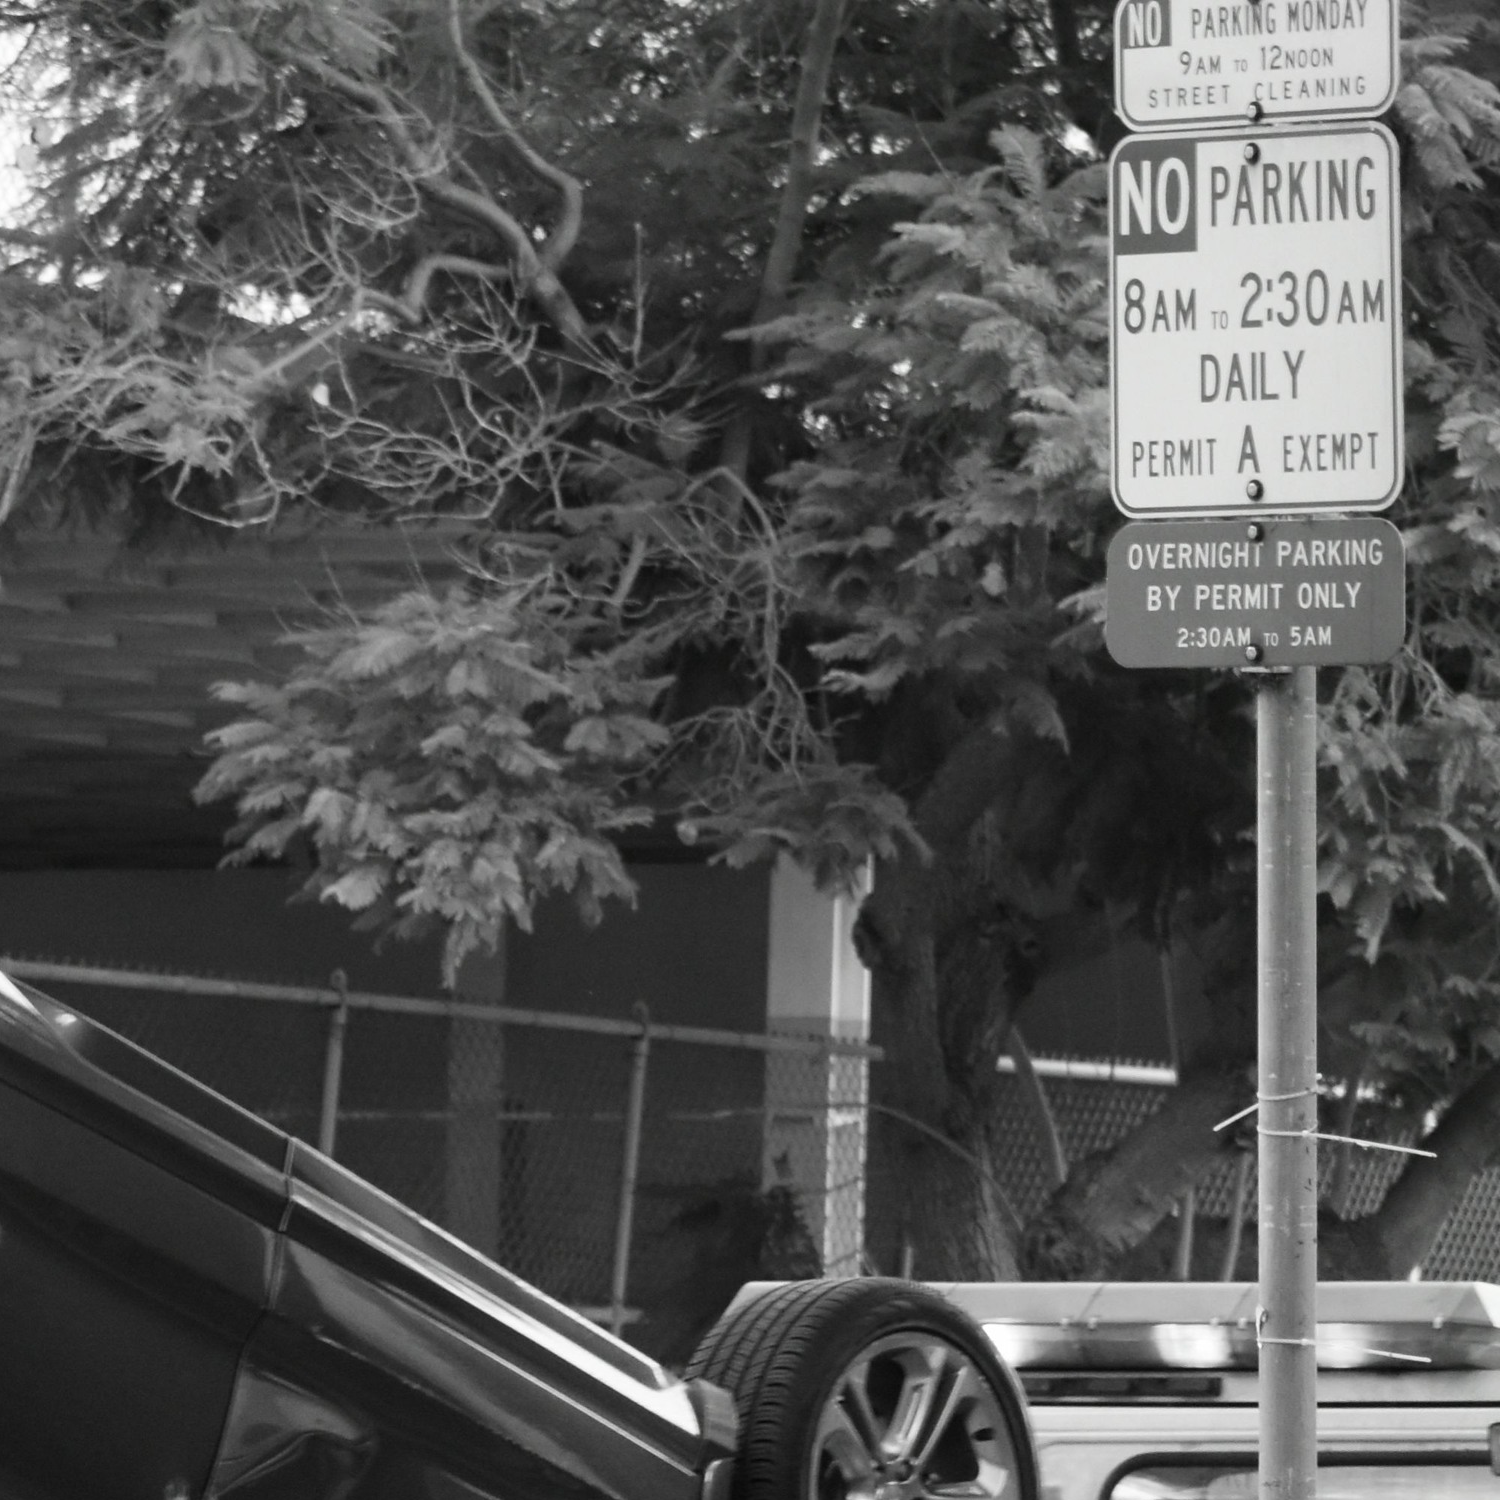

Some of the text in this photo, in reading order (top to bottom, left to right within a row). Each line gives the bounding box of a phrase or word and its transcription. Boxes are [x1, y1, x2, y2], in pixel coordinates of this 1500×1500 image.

[1129, 0, 1367, 47] NO PARKING MONDAY
[1180, 46, 1334, 75] 9AM TO 12NOON
[1149, 76, 1366, 108] STREET CLEANING
[1119, 156, 1376, 236] NO PARKING
[1124, 269, 1385, 334] 8AM TO 2:30AM
[1200, 350, 1305, 403] DAILY
[1132, 425, 1379, 478] PERMIT A EXEMPT
[1128, 539, 1383, 570] OVERNIGHT PARKING
[1147, 581, 1362, 611] BY PERMIT ONLY
[1177, 626, 1332, 648] 2:30AM TO 5AM
